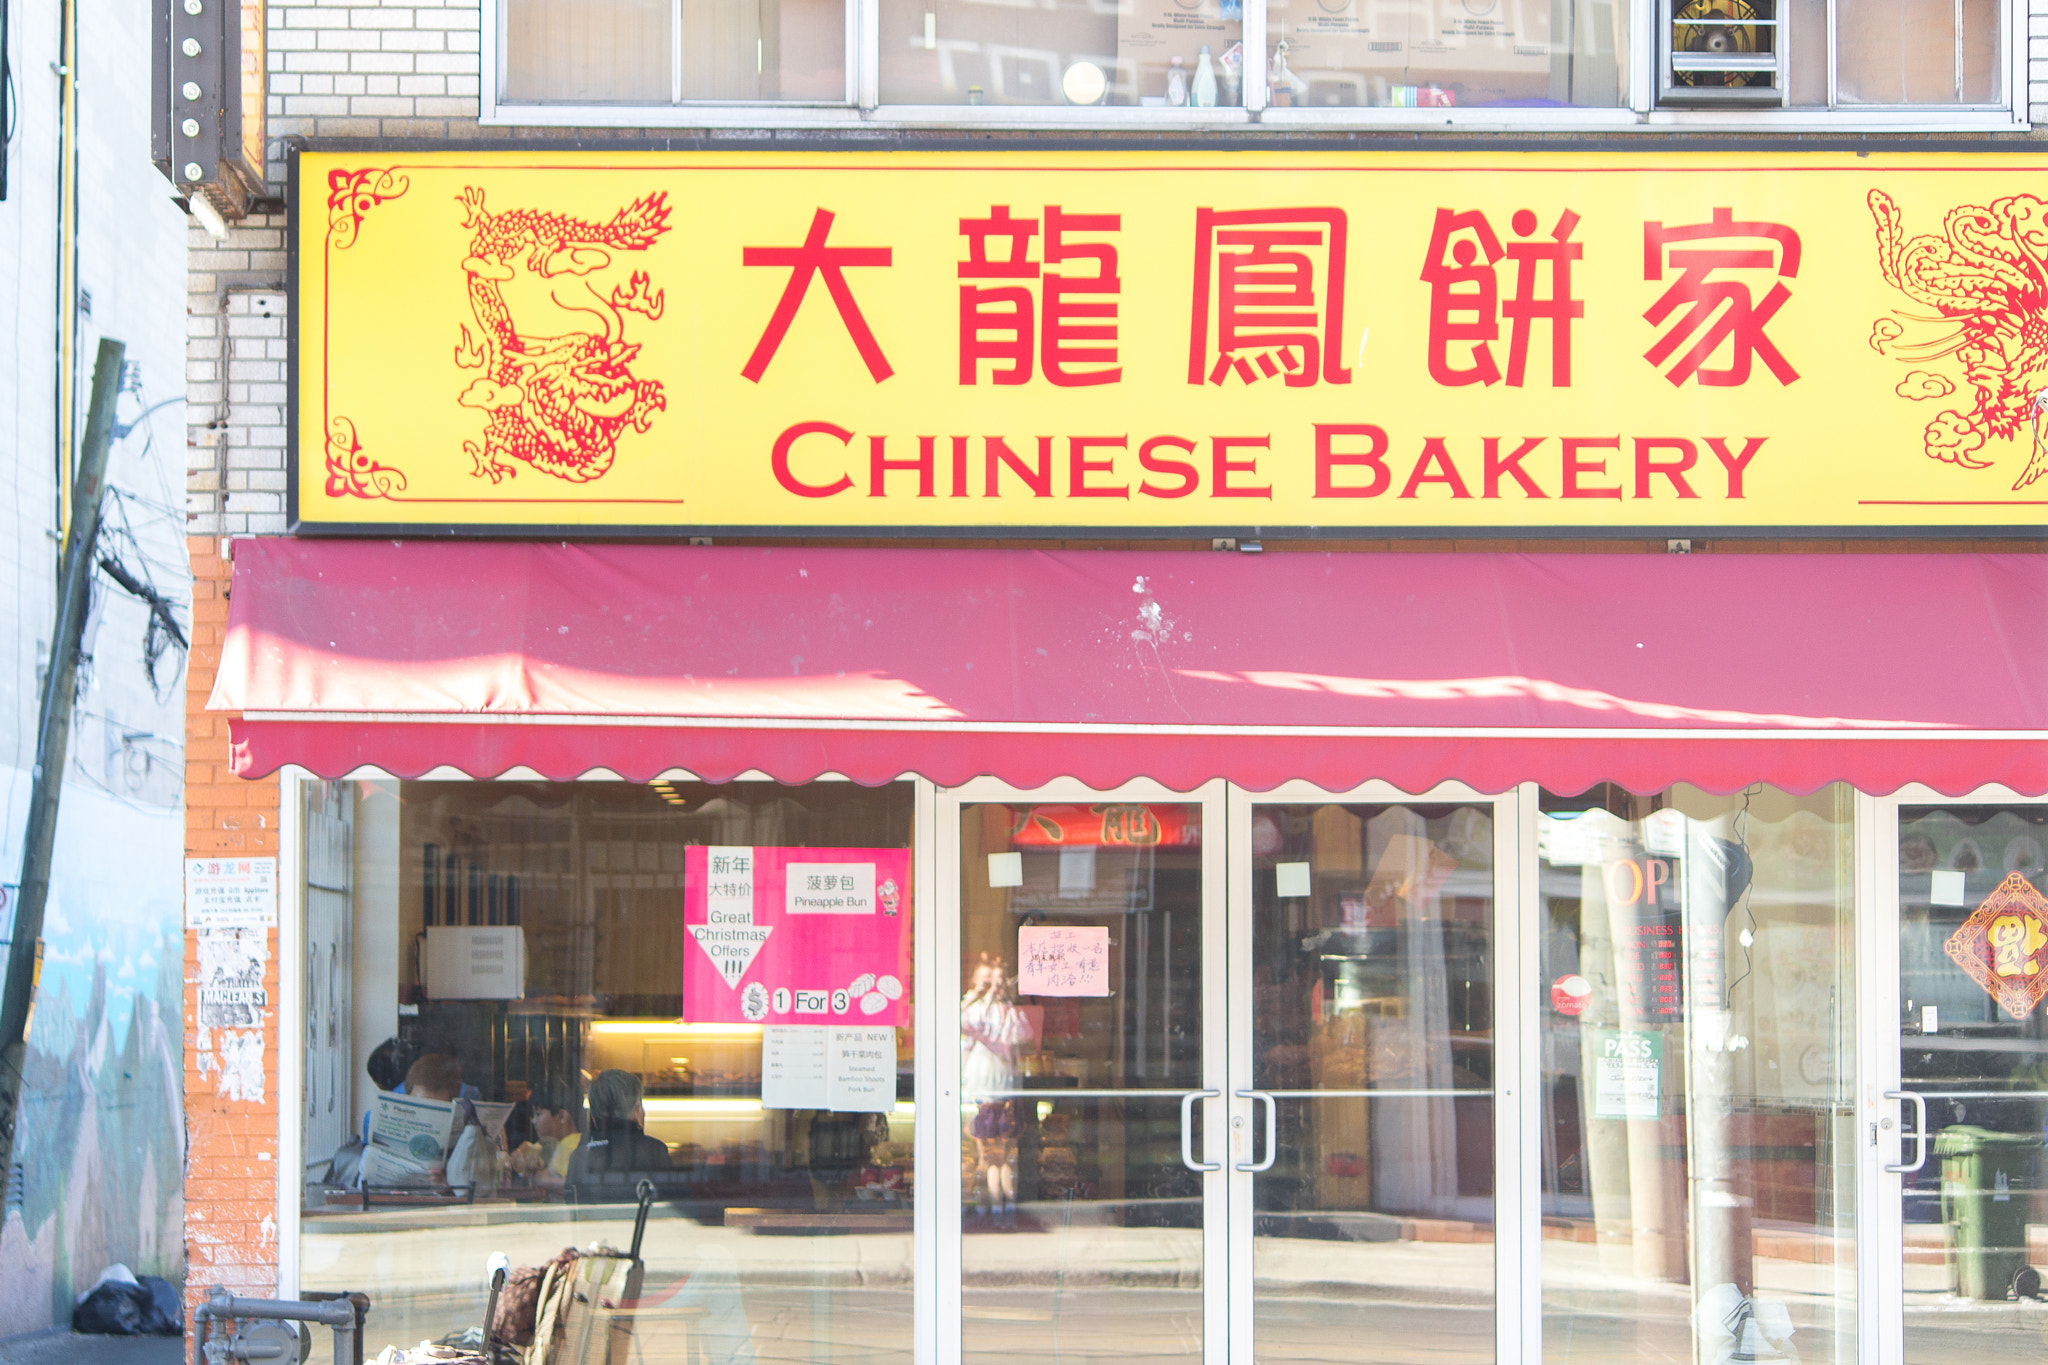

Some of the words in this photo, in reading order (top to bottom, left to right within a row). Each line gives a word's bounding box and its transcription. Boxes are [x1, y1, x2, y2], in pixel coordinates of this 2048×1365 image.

[740, 205, 1801, 388] 大龍鳳餅家
[771, 421, 1272, 501] CHINESE
[1311, 422, 1770, 502] BAKERY
[711, 856, 750, 875] 新年
[708, 882, 752, 897] 大特价
[807, 875, 855, 891] 菠萝包
[794, 896, 844, 908] Pineapple
[846, 896, 867, 907] Bun
[710, 910, 751, 924] Great
[694, 928, 767, 942] Christmas
[710, 944, 750, 957] Offers
[775, 992, 783, 1008] 1
[796, 993, 826, 1010] For
[833, 993, 846, 1010] 3
[1557, 1001, 1588, 1010] zomato
[867, 1033, 888, 1042] NEW
[1605, 1039, 1652, 1058] PASS
